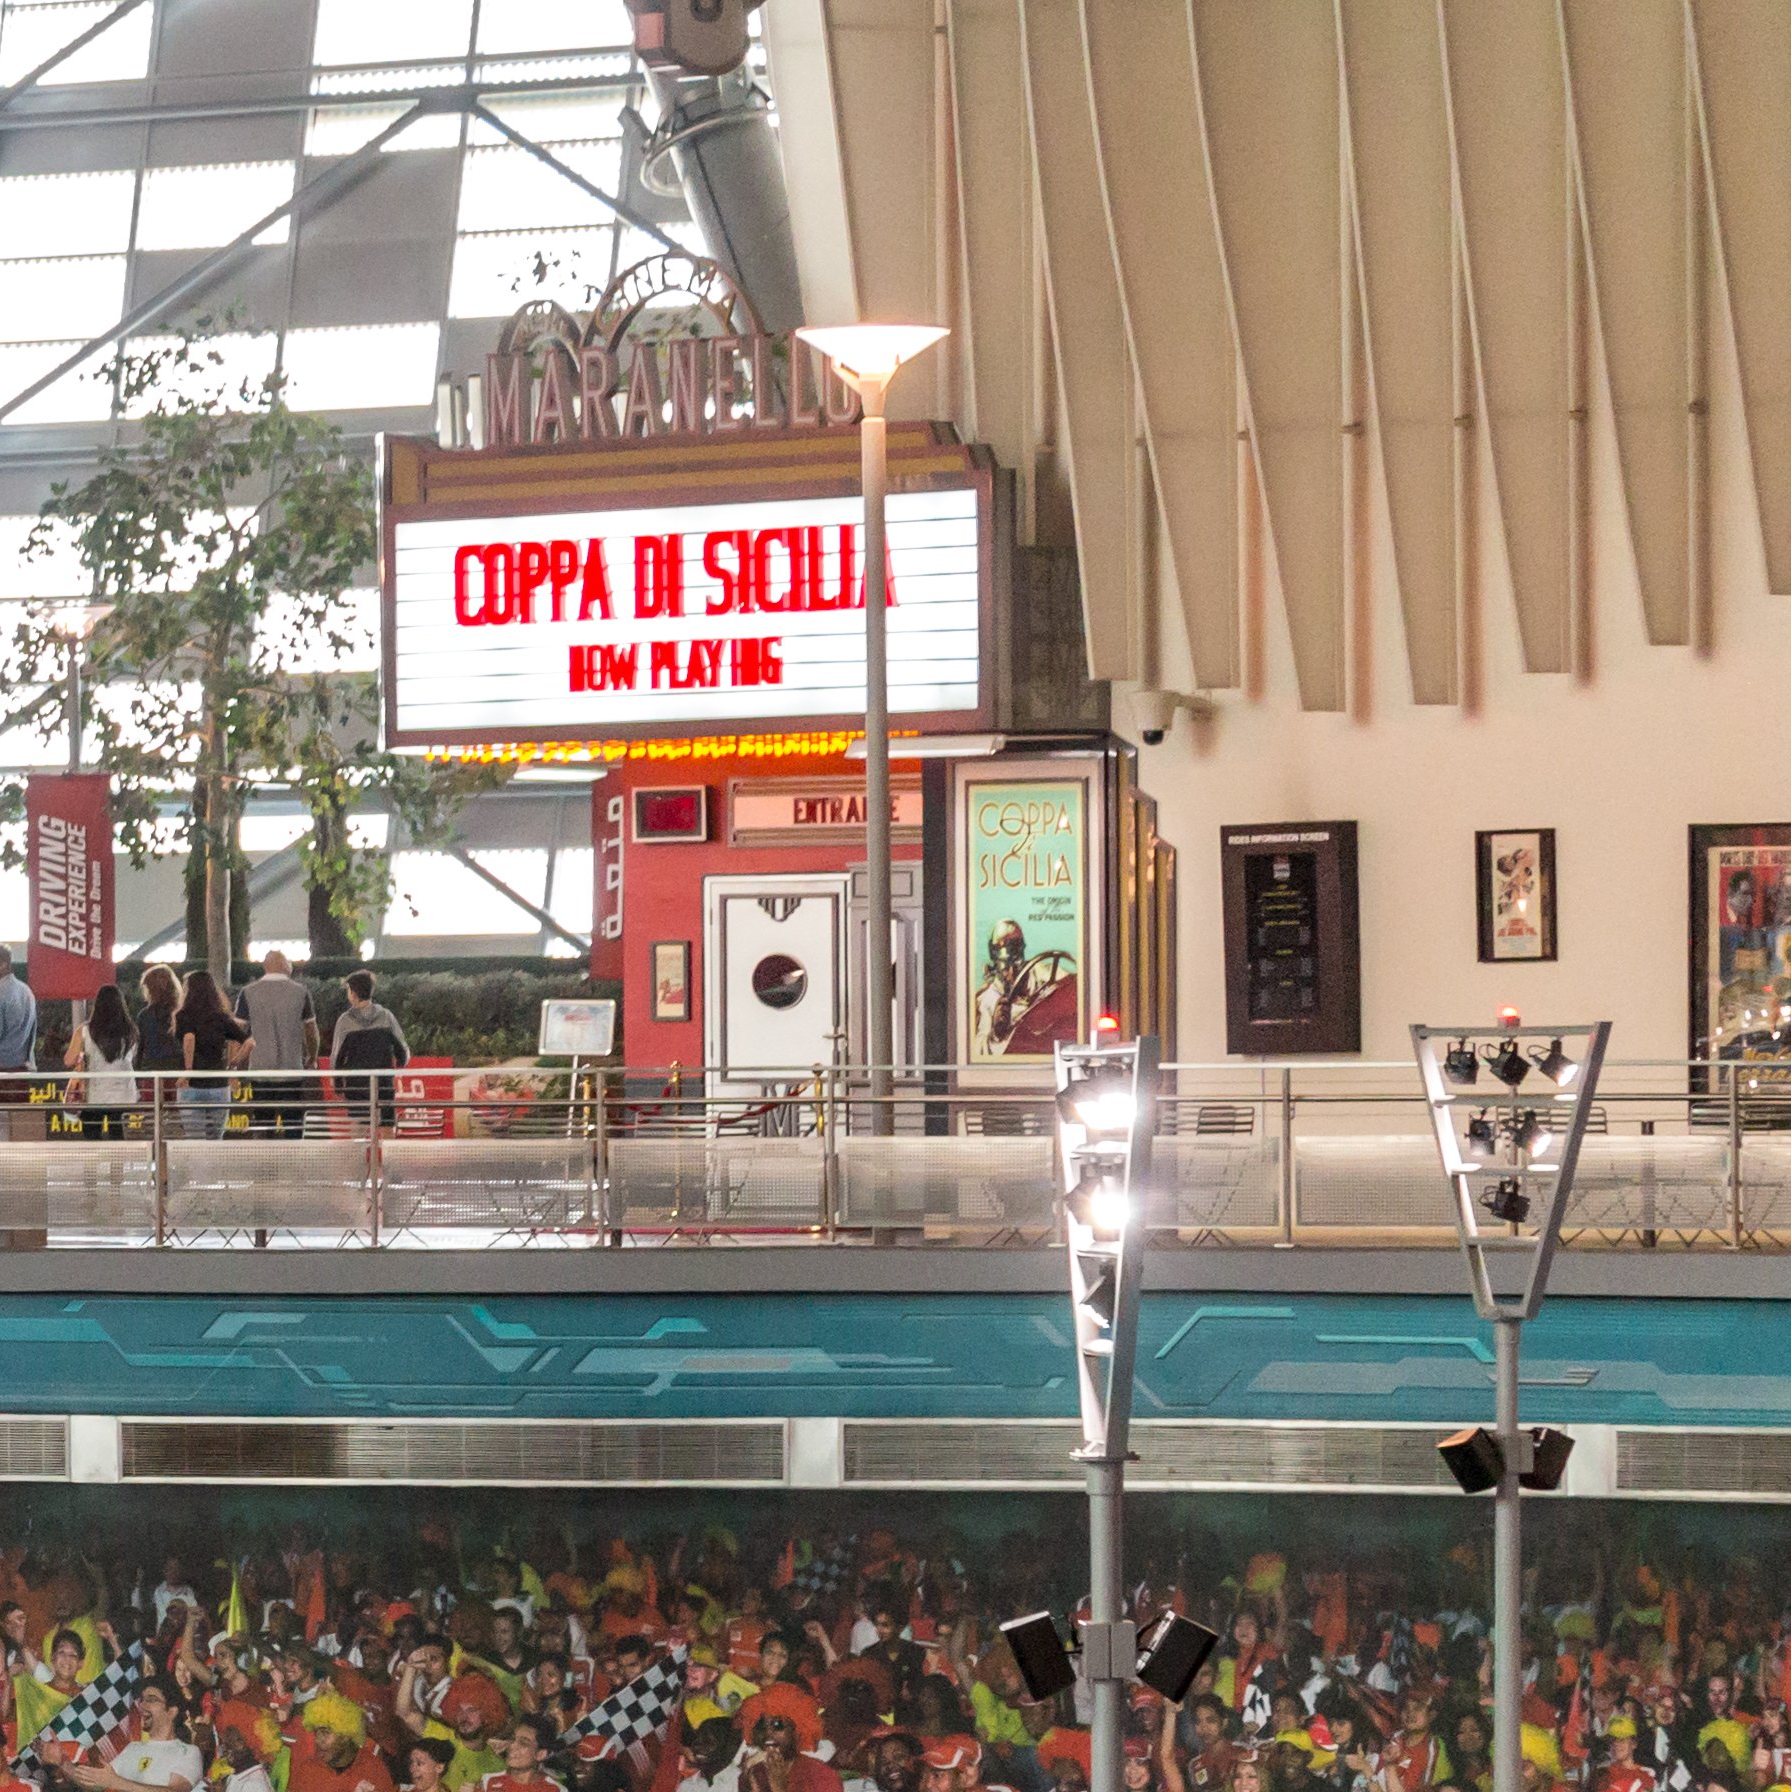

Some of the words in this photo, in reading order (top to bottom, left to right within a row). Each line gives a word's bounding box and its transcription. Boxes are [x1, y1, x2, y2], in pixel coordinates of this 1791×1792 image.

[486, 327, 862, 447] MARANELLO
[454, 538, 618, 626] COPPA
[634, 533, 685, 619] DI
[569, 642, 638, 692] NOW
[651, 636, 784, 690] PLAYING
[793, 795, 900, 823] ENTRAE
[979, 801, 1073, 836] COPPA
[38, 815, 67, 950] DRIVING
[67, 821, 86, 956] EXPERIENCE
[980, 852, 1073, 888] SICILIA
